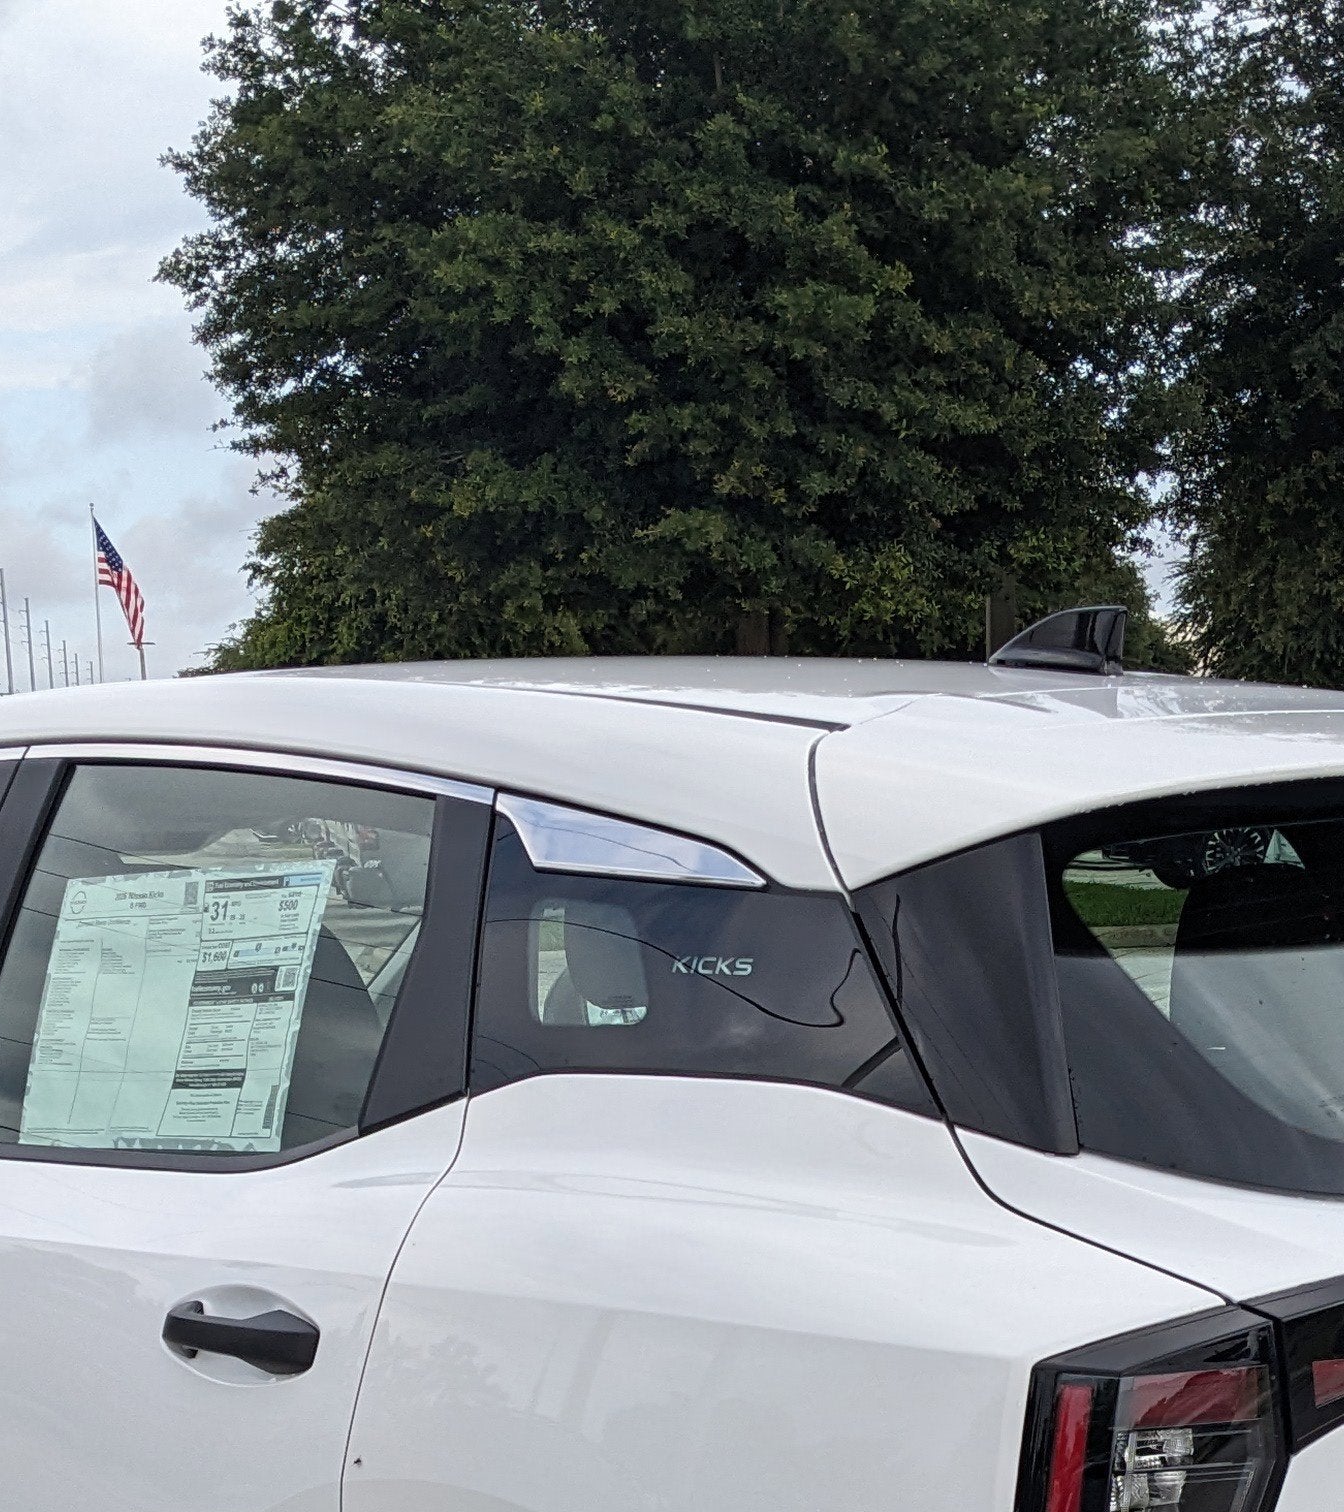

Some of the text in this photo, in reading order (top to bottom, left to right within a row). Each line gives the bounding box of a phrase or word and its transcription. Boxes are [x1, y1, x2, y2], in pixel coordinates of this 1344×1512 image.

[210, 900, 229, 921] 31
[278, 900, 299, 912] $500
[671, 955, 754, 976] KICKS
